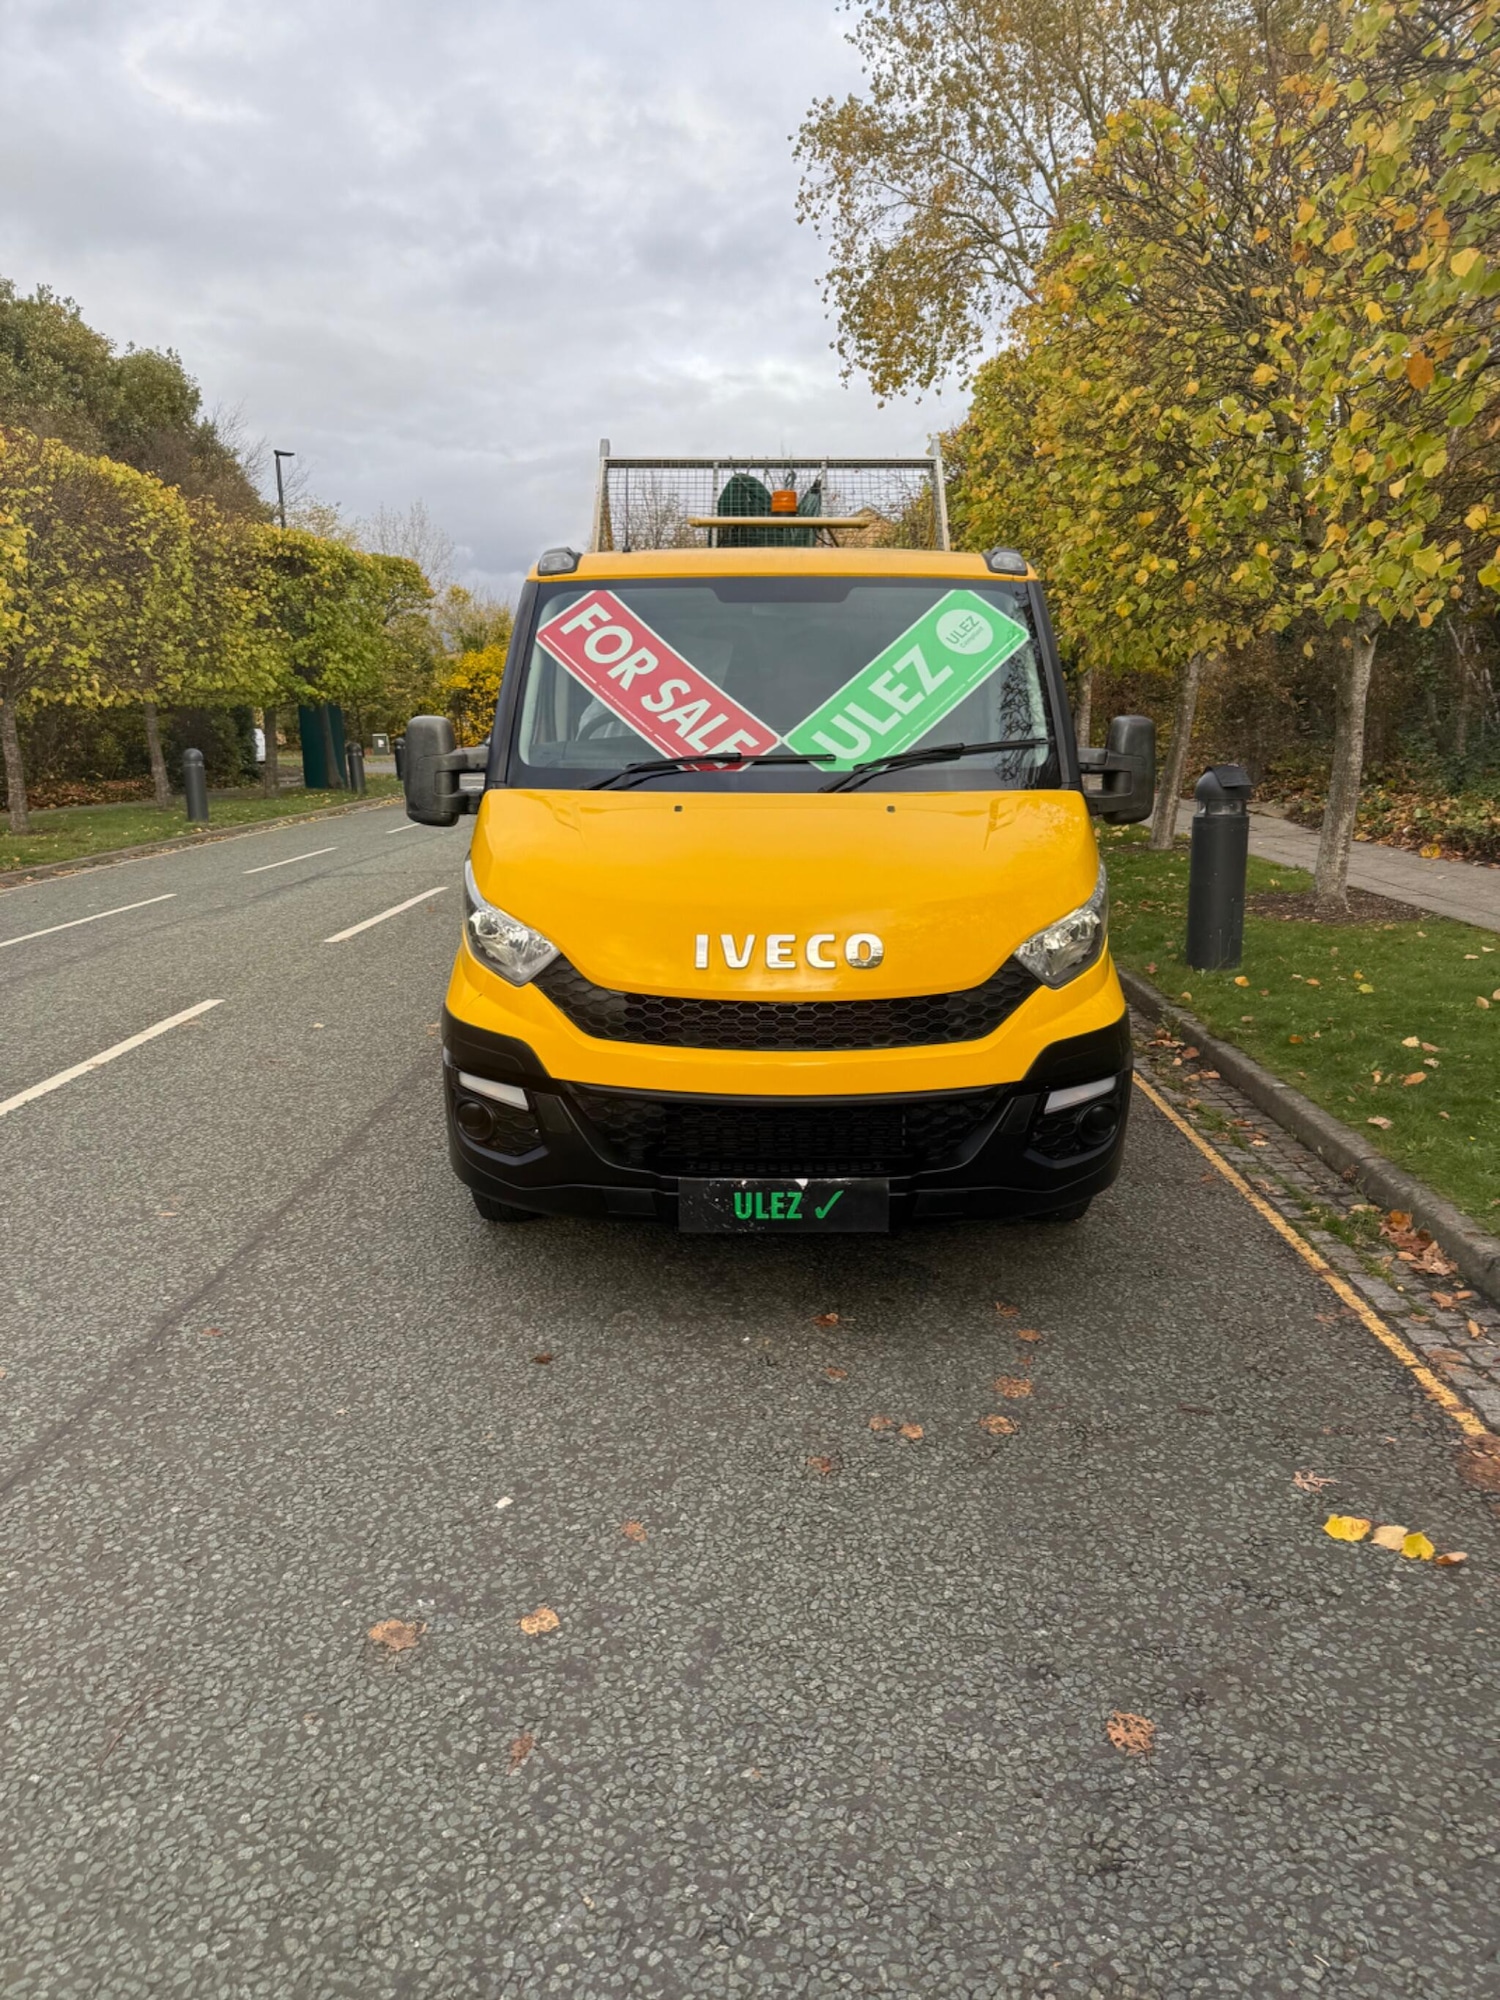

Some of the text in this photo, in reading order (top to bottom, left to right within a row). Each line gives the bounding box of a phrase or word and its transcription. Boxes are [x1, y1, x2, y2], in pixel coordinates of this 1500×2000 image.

[945, 615, 980, 645] ULEZ
[559, 602, 659, 691] FOR
[641, 679, 760, 769] SALE
[811, 644, 954, 759] ULEZ
[694, 933, 884, 969] IVECO
[733, 1191, 803, 1219] ULEZ
